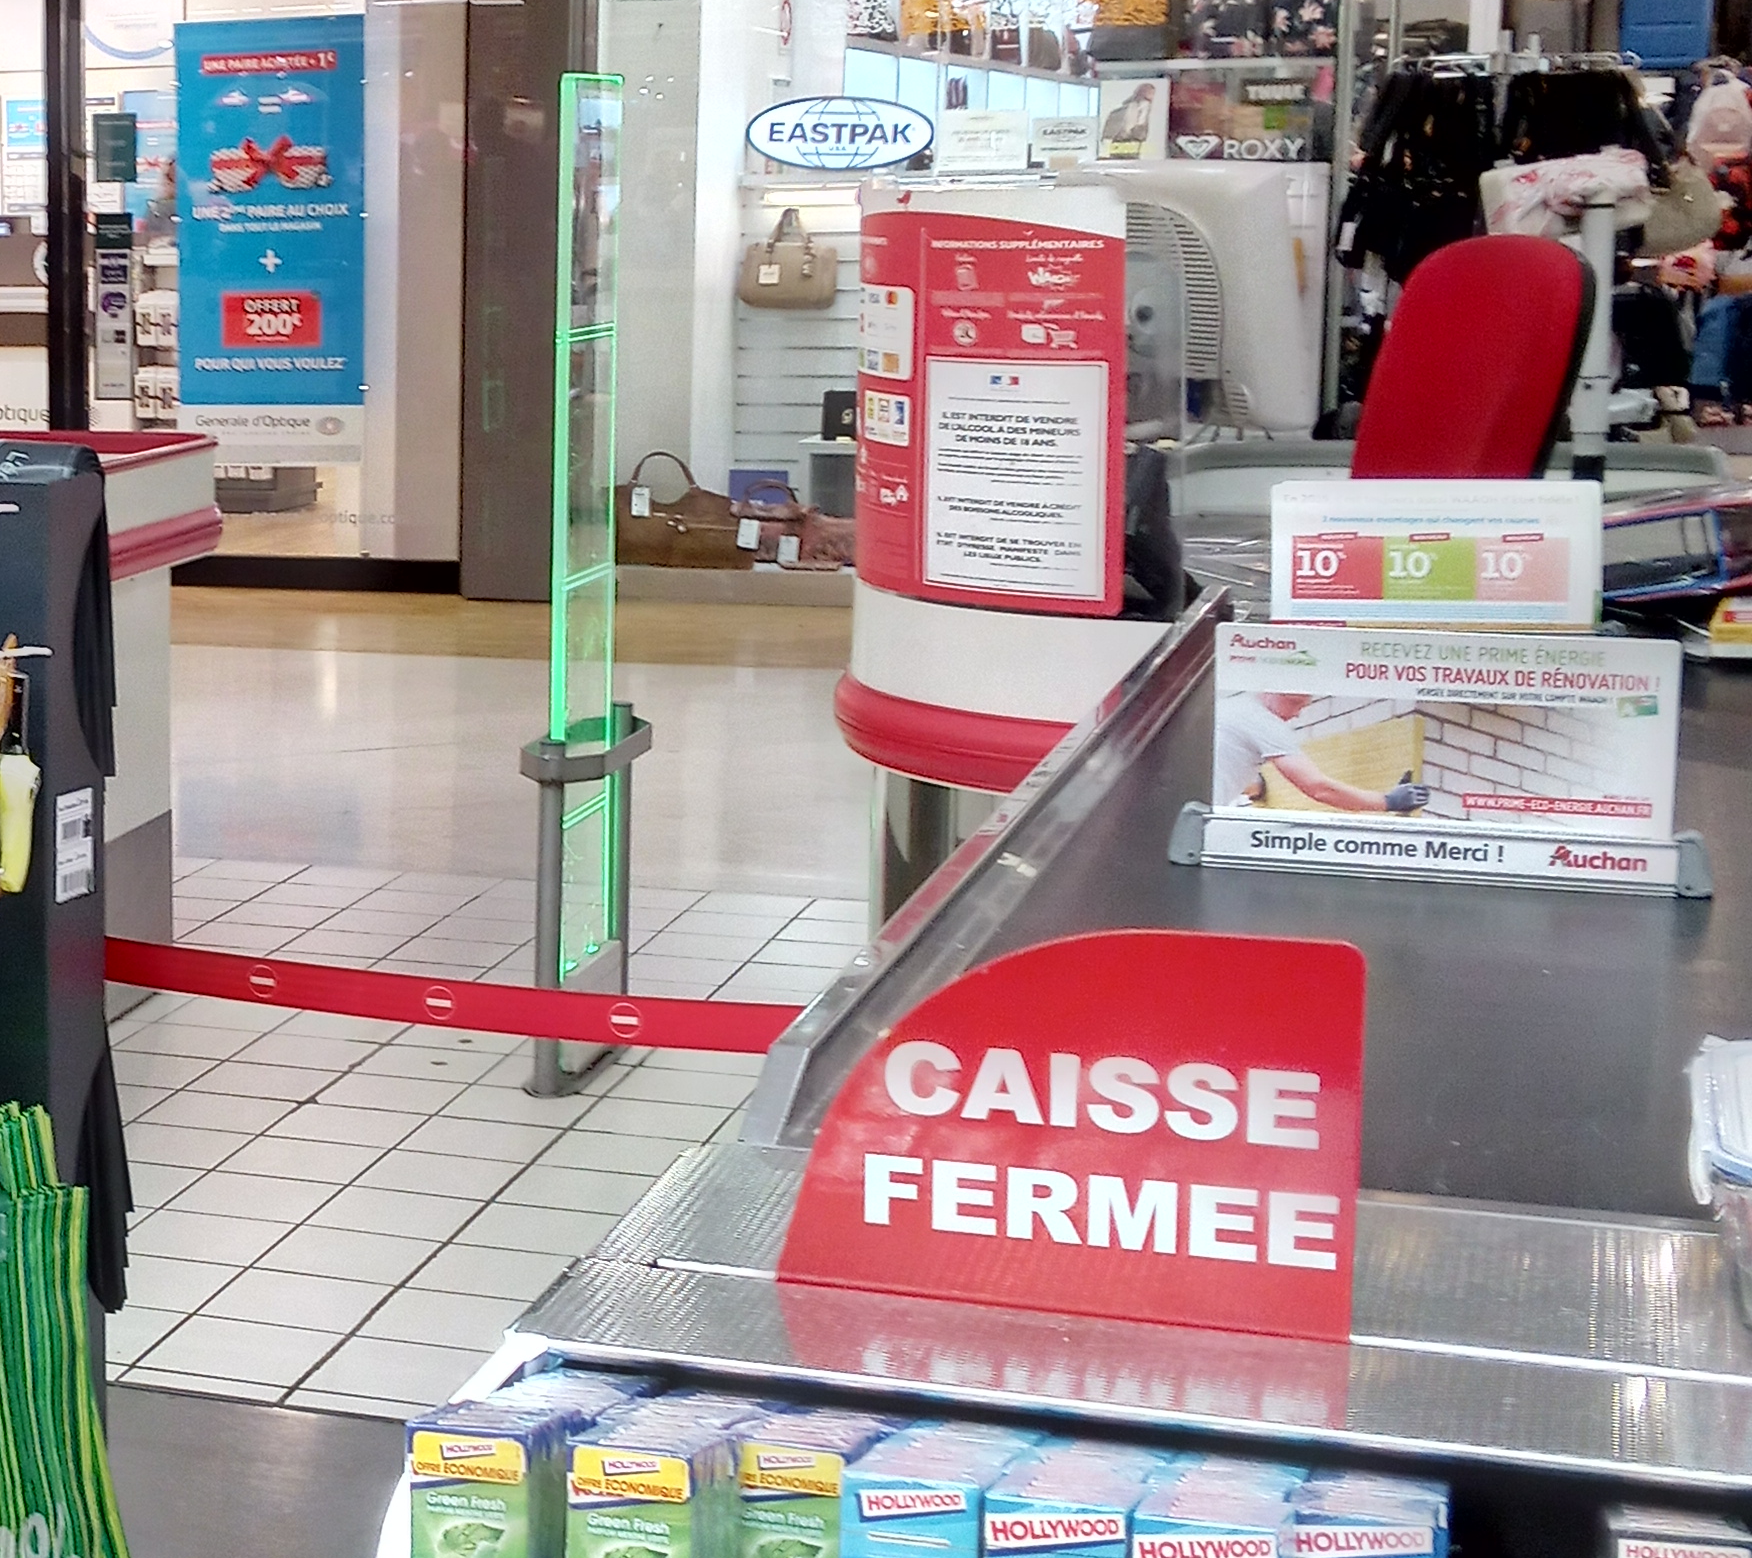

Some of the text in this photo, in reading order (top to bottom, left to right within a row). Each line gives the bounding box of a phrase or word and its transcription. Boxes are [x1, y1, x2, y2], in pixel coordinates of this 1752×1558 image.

[769, 123, 912, 143] EASTPAK
[1224, 139, 1304, 159] ROXY
[307, 203, 348, 215] CHOIX
[243, 297, 300, 314] OFFERT
[1230, 634, 1297, 650] Auchan
[1362, 642, 1606, 668] RECEVEZ UNE PRIME ÉNERGIE
[1346, 663, 1649, 691] POUR VOS TRAVAUX DE RÉNOVATION
[1250, 830, 1328, 855] Simple
[1333, 838, 1419, 859] comme
[1424, 839, 1490, 864] Merci
[1548, 844, 1648, 873] Auchan
[884, 1040, 1321, 1150] CAISSE
[862, 1152, 1340, 1270] FERMEE
[867, 1493, 962, 1512] HOLLYWOOD
[990, 1517, 1121, 1542] HOLLYWOOD
[1295, 1531, 1424, 1553] HOLLYWOOD
